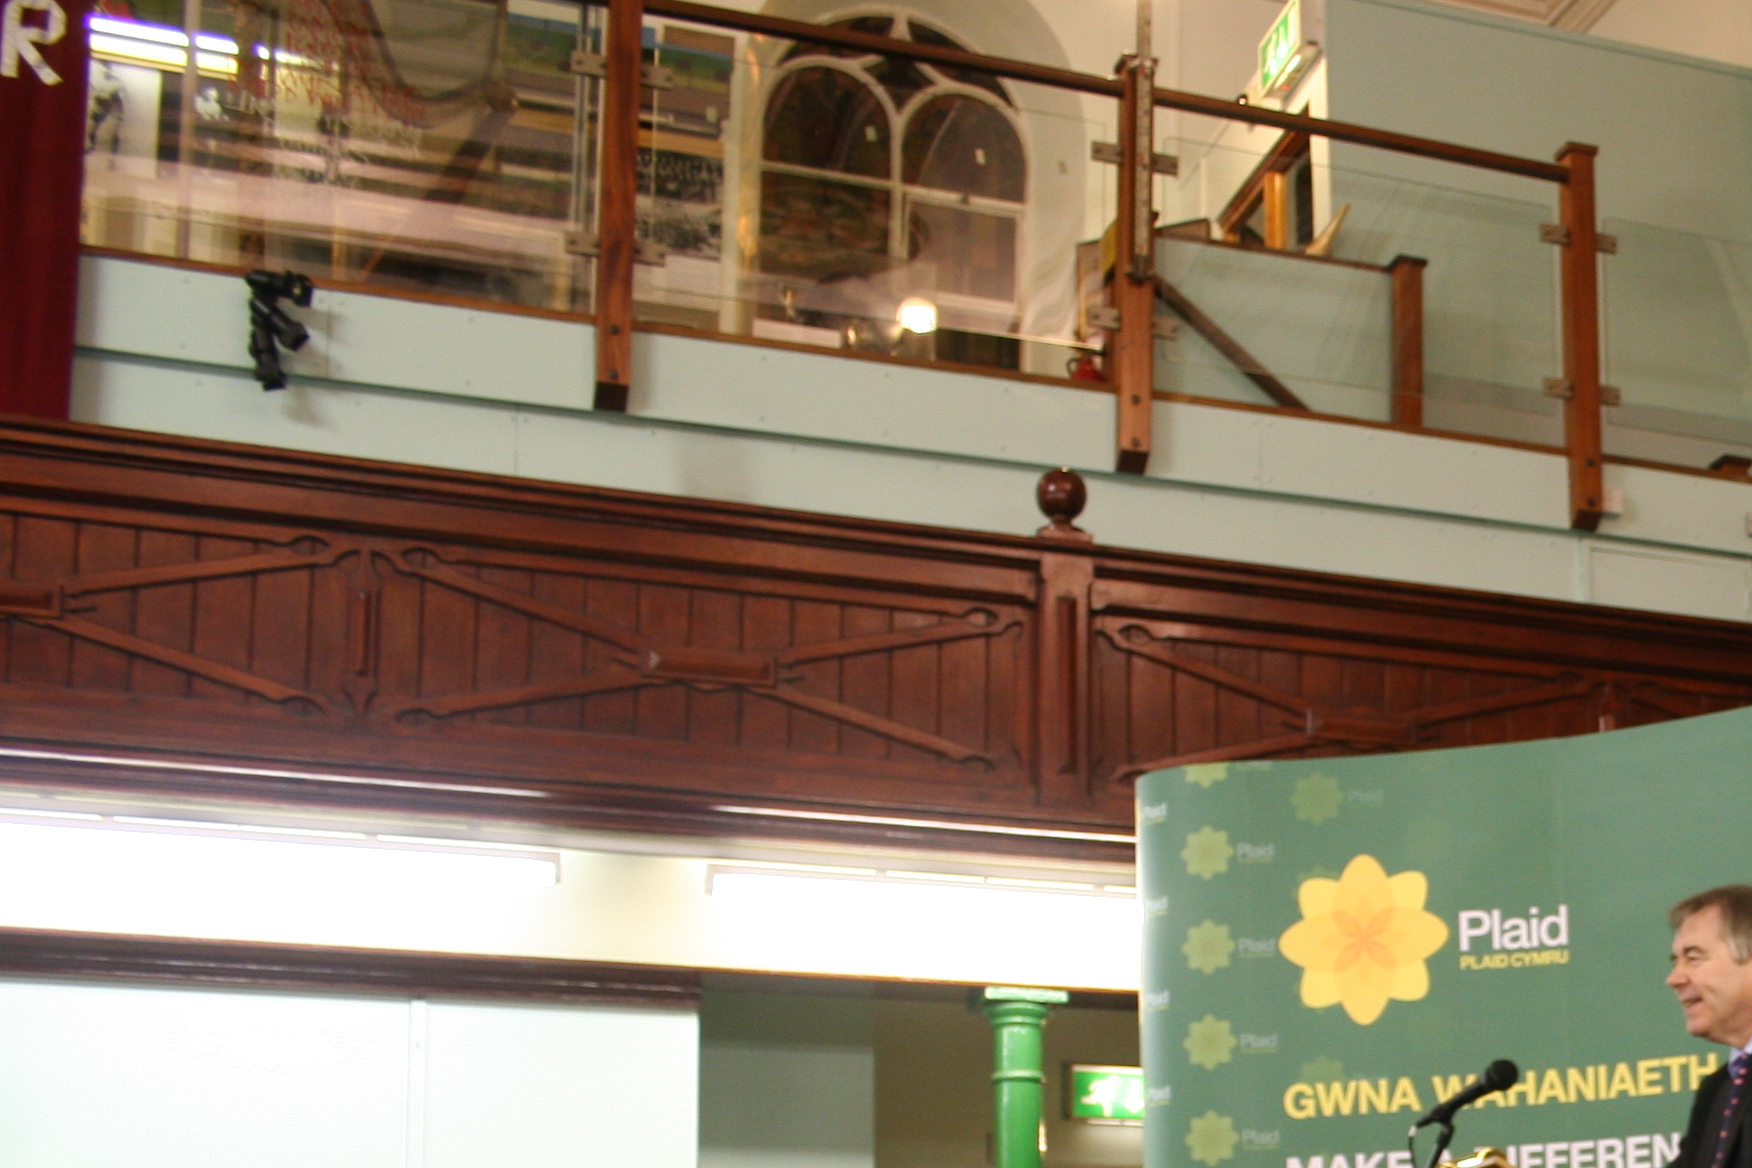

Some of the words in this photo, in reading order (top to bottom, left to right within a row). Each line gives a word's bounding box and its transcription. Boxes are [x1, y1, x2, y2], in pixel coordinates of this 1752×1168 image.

[0, 0, 67, 86] R
[1458, 903, 1569, 953] Plaid
[1459, 952, 1510, 971] PLAID
[1283, 1075, 1424, 1121] GWNA
